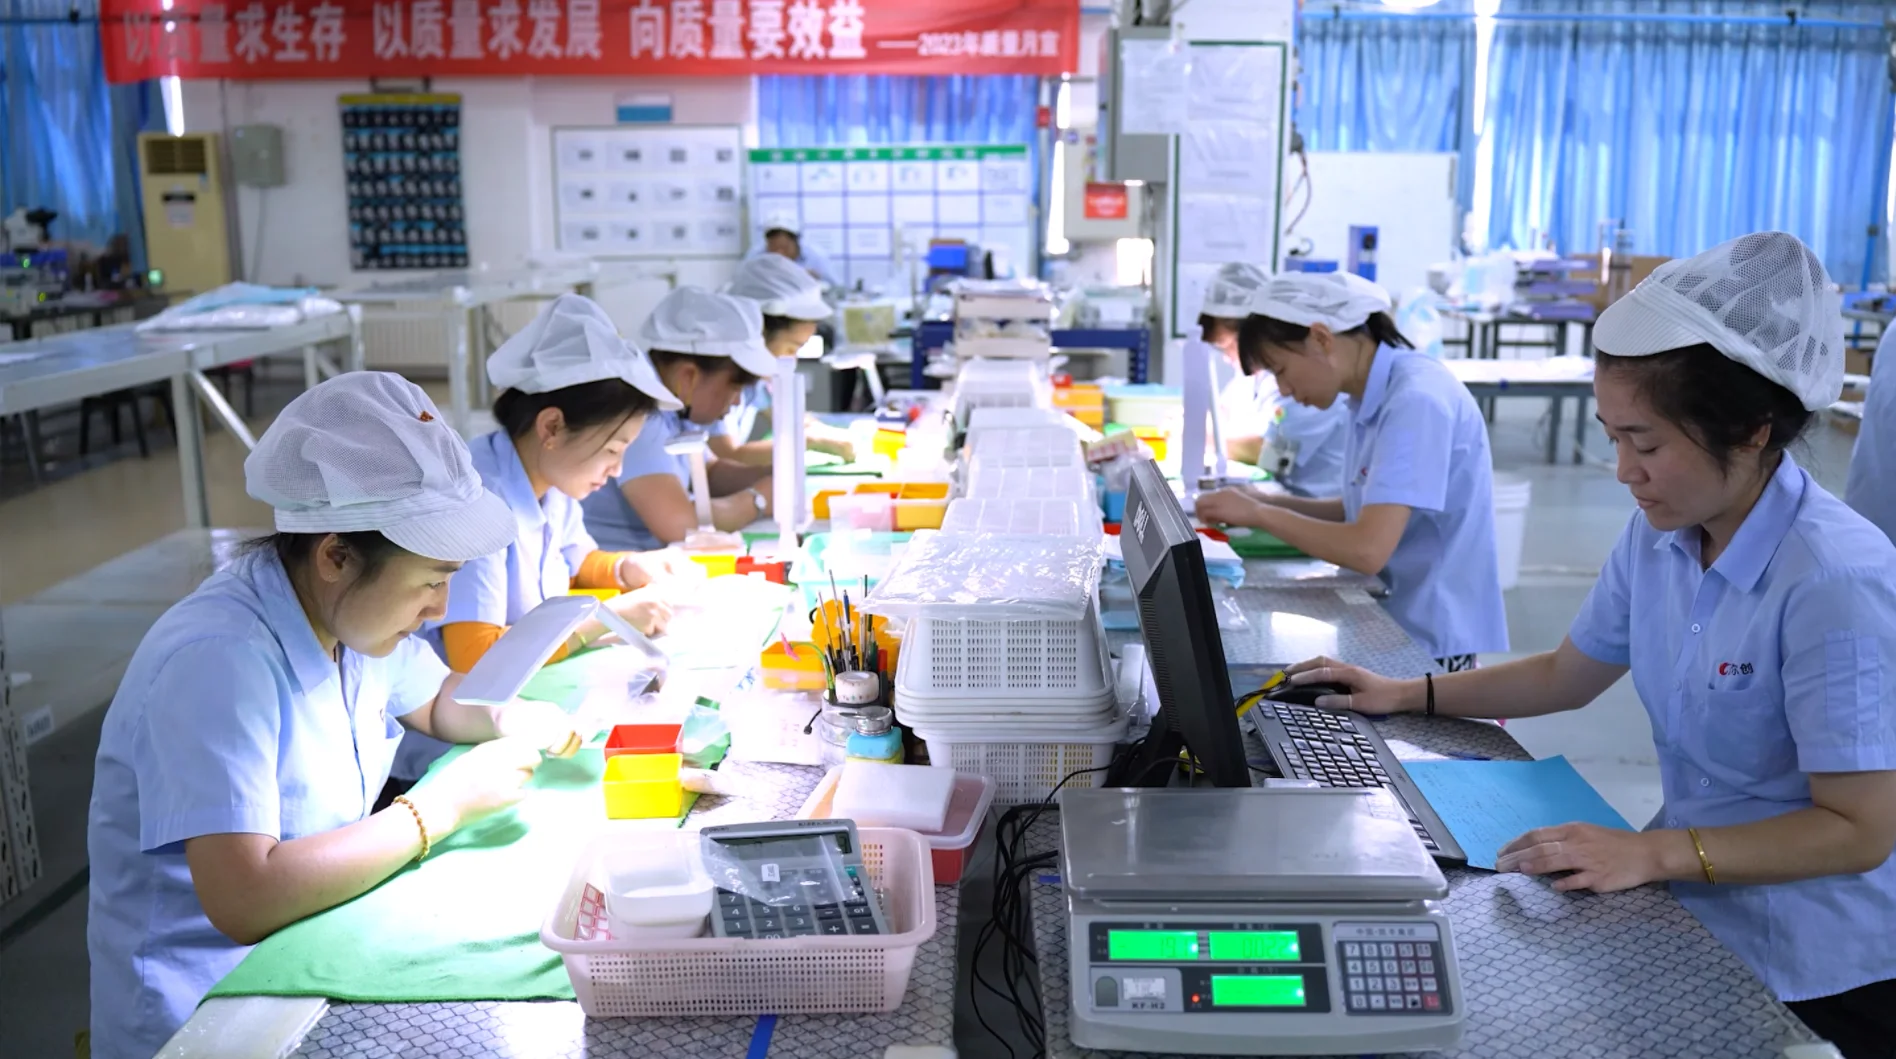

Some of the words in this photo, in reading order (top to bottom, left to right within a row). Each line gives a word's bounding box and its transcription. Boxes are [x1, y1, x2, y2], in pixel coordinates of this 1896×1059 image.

[372, 0, 602, 60] 以质量求发展
[629, 0, 867, 60] 向质量要效益
